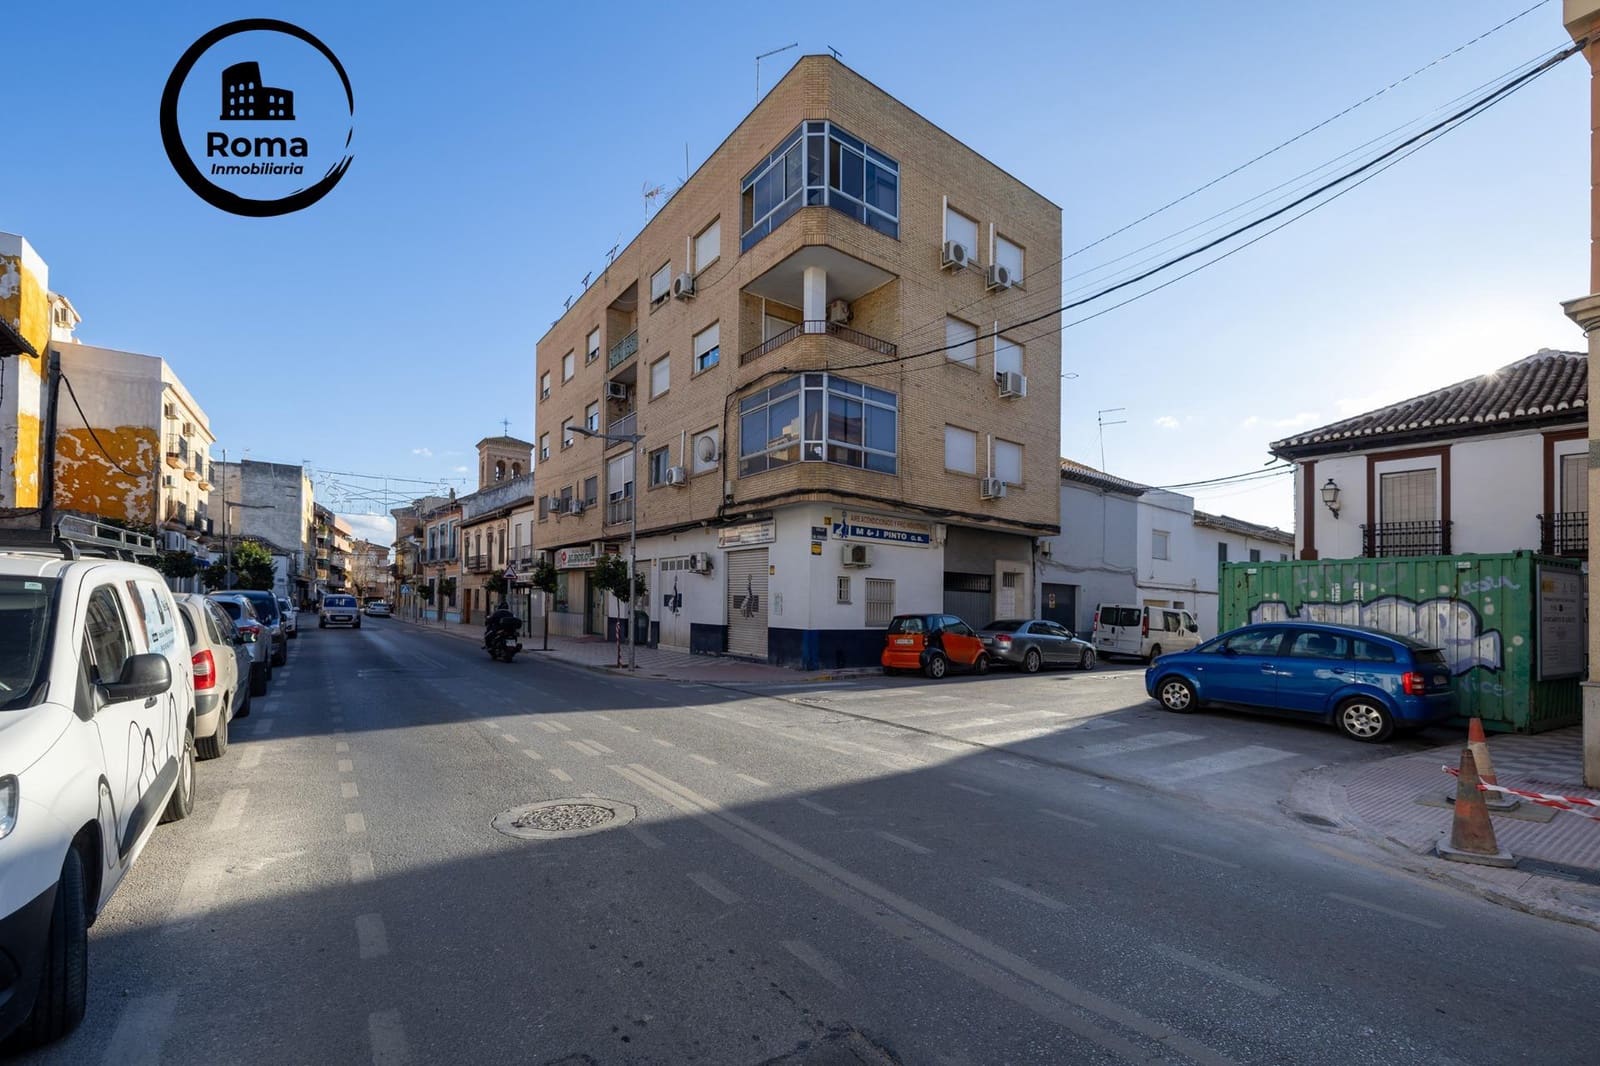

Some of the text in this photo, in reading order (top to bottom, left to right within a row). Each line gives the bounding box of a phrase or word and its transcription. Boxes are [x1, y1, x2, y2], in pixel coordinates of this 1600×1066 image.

[855, 527, 864, 536] M
[875, 529, 880, 537] J
[883, 530, 908, 540] PINTO
